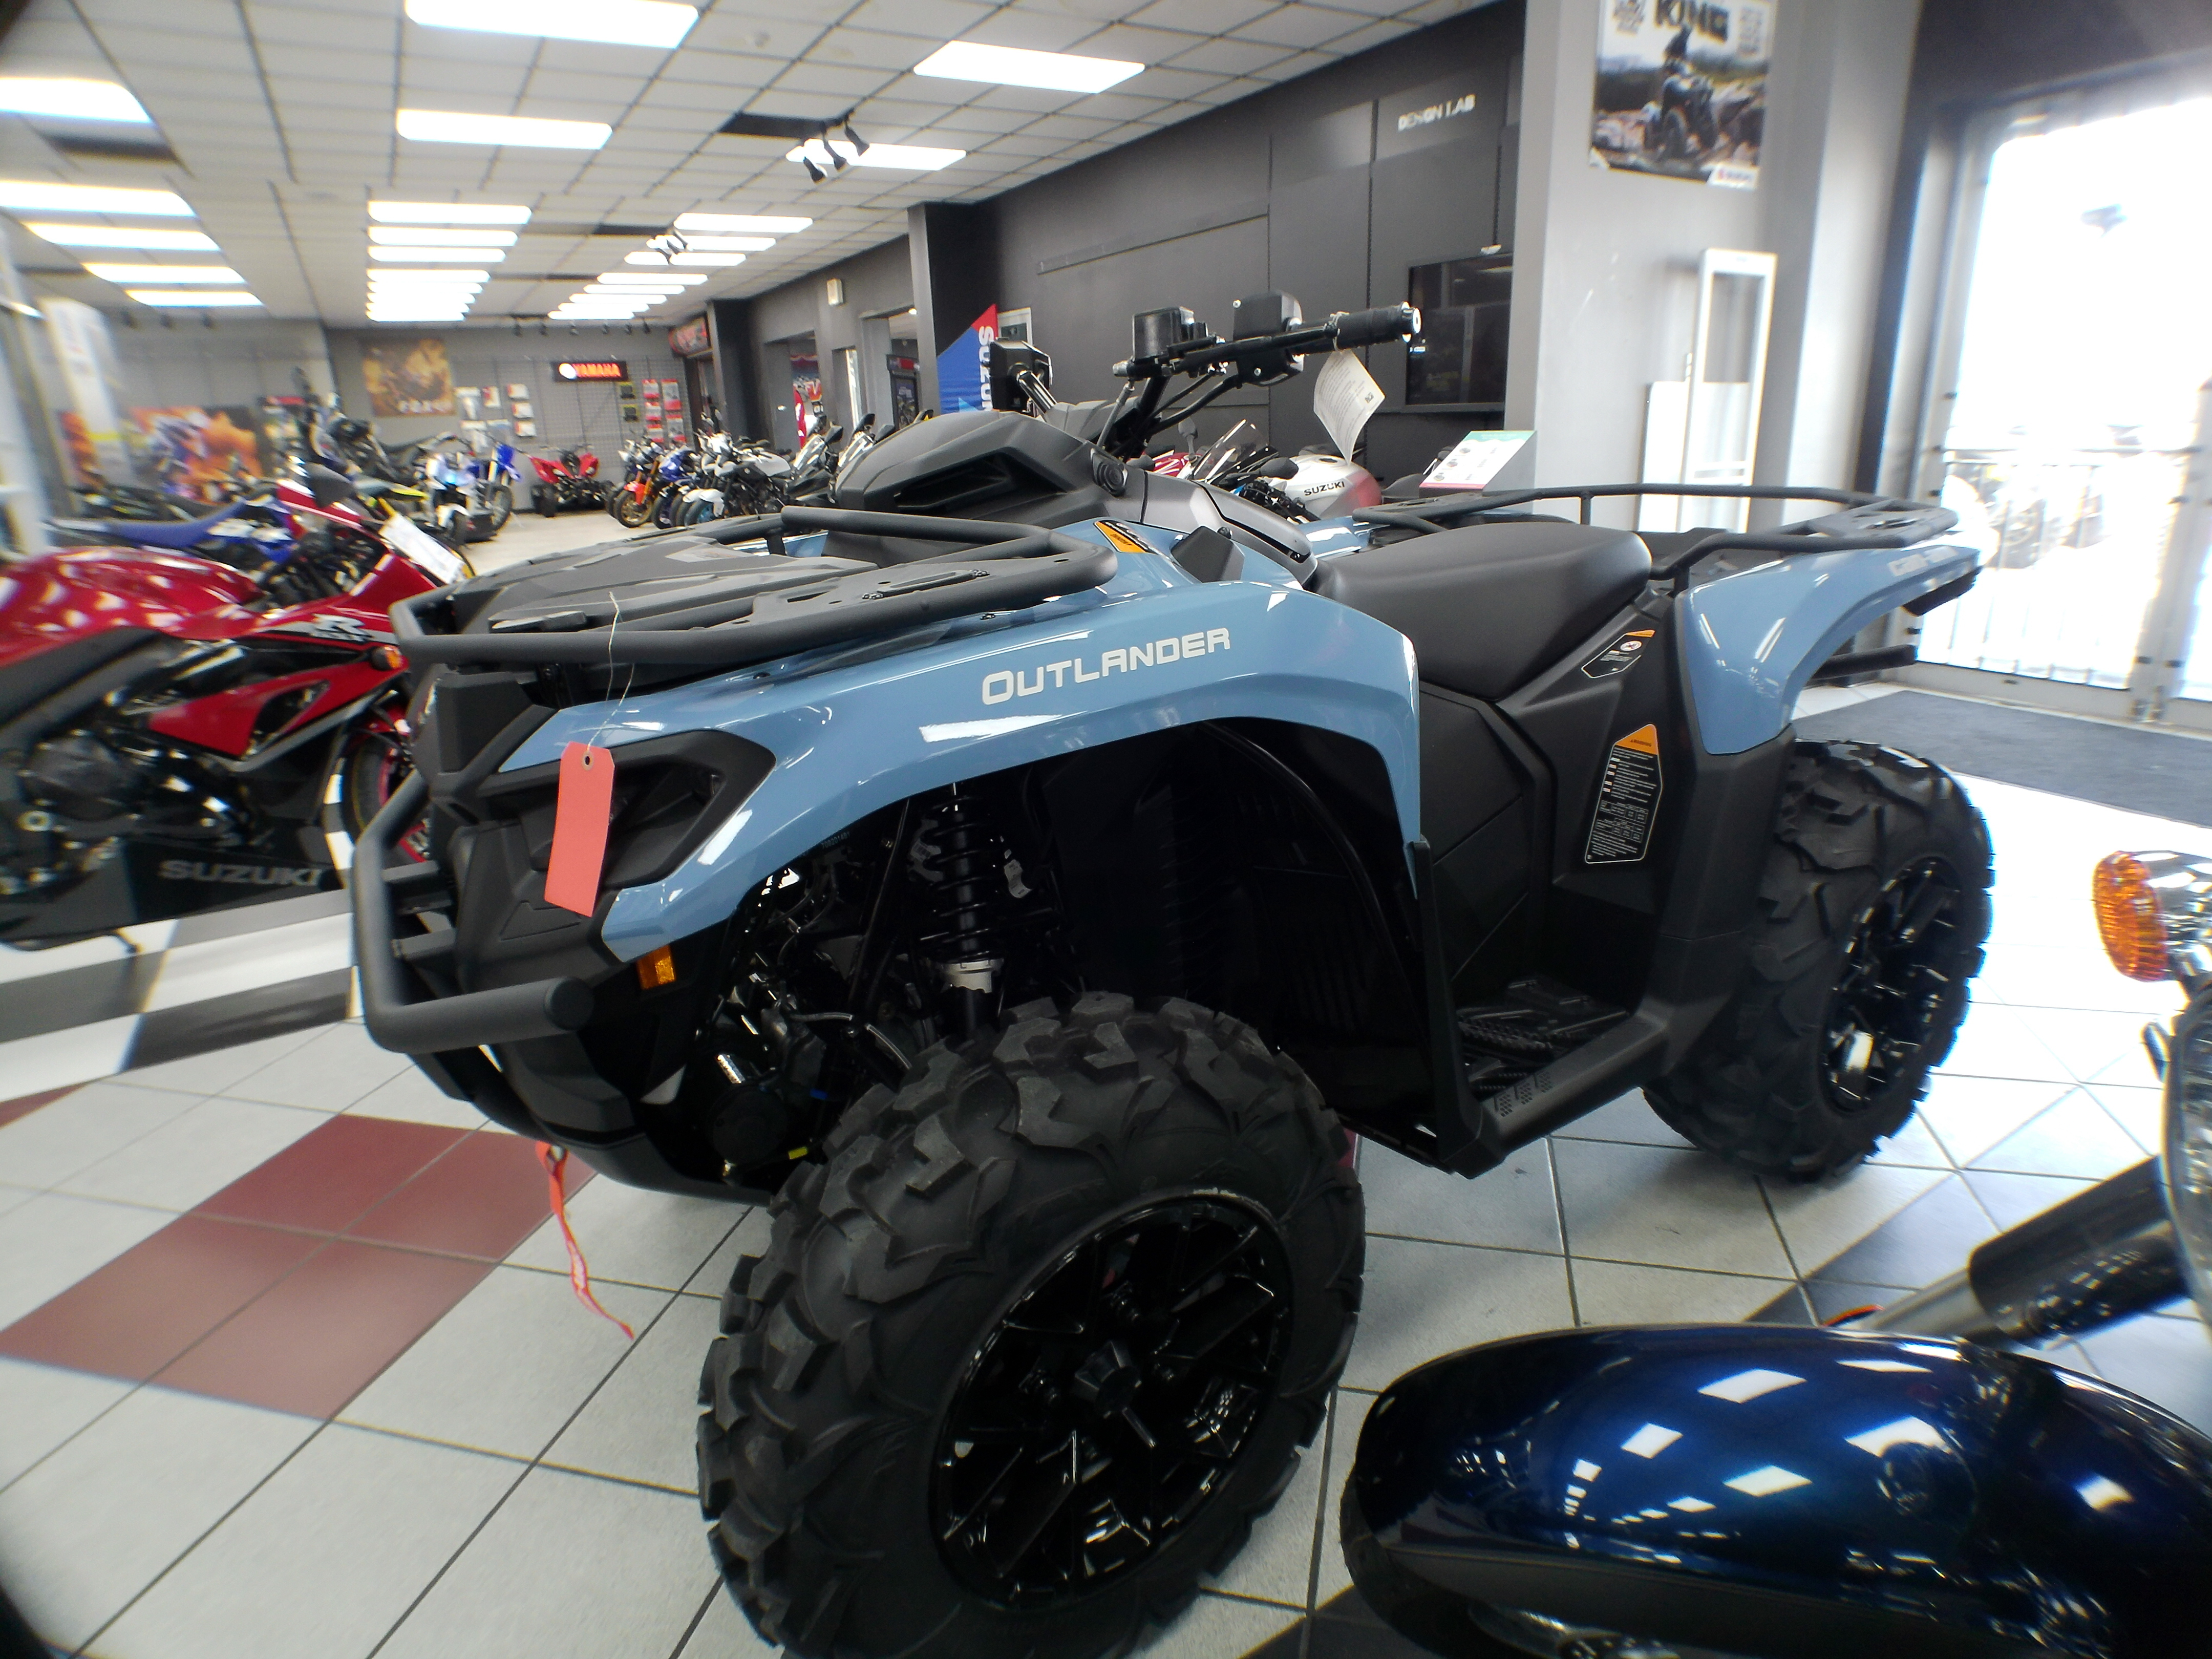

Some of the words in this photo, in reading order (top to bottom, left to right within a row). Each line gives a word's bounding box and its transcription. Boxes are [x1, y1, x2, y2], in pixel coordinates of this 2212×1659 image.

[1398, 104, 1443, 133] DESIGN
[1445, 94, 1476, 118] LAB
[571, 363, 622, 377] YAMAHA
[1304, 481, 1345, 496] SUZUKI
[982, 628, 1230, 706] OUTLANDER
[159, 859, 322, 886] SUZUKI
